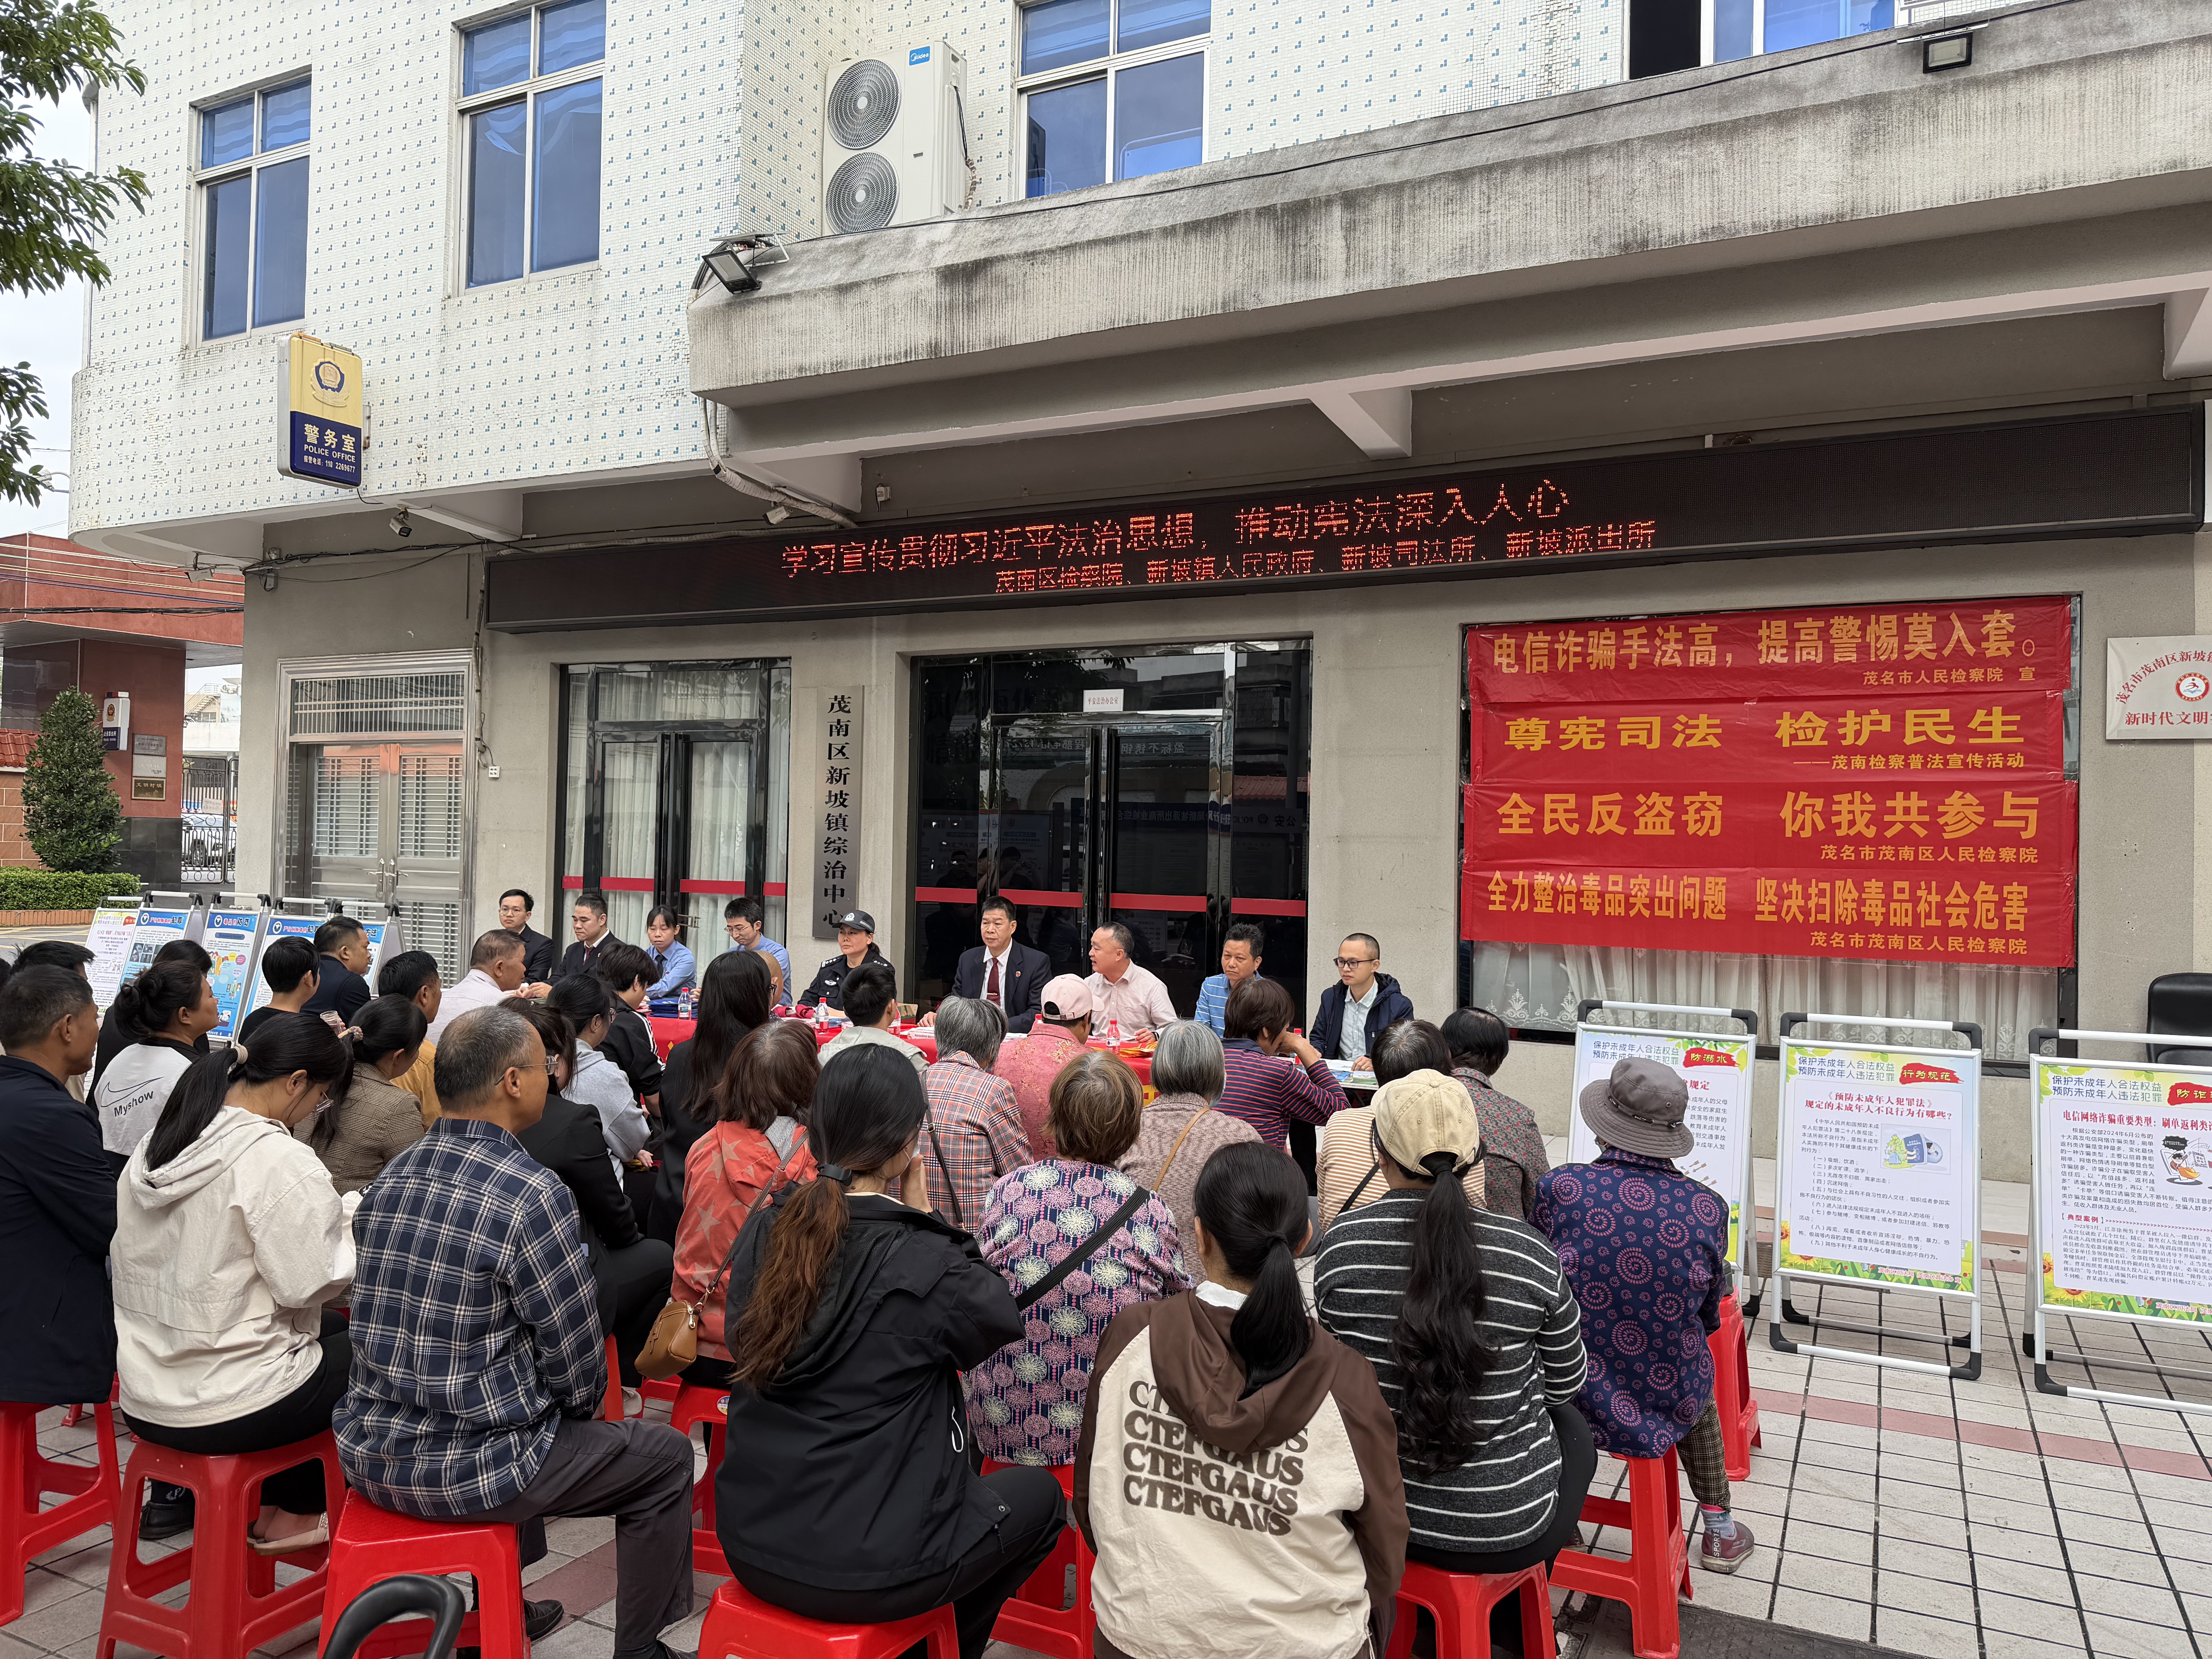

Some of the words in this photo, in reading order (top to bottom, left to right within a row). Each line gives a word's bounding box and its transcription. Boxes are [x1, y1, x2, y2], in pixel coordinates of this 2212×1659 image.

[910, 52, 929, 62] Midea
[304, 423, 356, 453] 警务室
[304, 444, 329, 457] POLICE
[332, 451, 356, 463] OFFICE
[335, 462, 355, 473] 2269677
[1862, 667, 2004, 685] 茂名市人民检察院
[2019, 666, 2036, 682] 宣
[1088, 697, 1119, 705] 平安法治办公室
[2124, 711, 2212, 726] 新时代文明
[1504, 713, 1722, 751] 尊宪司法
[1775, 706, 2024, 748] 检护民生
[823, 695, 852, 926] 茂南区新坡镇综治中心
[1497, 791, 1722, 837] 全民反盗窃
[1779, 790, 2040, 840] 你我共参与
[1820, 844, 2039, 864] 茂名市茂南区人民检察院
[1487, 870, 1726, 921] 全力整治毒品突出问题
[1755, 877, 2028, 932] 坚决扫除毒品社会危害
[1810, 931, 2028, 955] 茂名市茂南区人民检察院
[1594, 1041, 1679, 1056] 保护未成年人合法权益
[1690, 1053, 1728, 1064] 防溺水
[1798, 1056, 1895, 1072] 保护未成年人合法权益
[1798, 1066, 1895, 1082] 预防未成年人违法犯罪
[1903, 1069, 1951, 1081] 行为规范
[2052, 1075, 2162, 1092] 保护未成年人合法权益
[1827, 1091, 1933, 1108] 《预防未成年人犯罪法》
[2052, 1085, 2162, 1103] 预防未成年人违法犯罪
[2176, 1088, 2212, 1100] 防诈
[113, 1089, 154, 1118] Myshow
[1805, 1099, 1952, 1120] 规定的未成年人不良行为有哪些？
[1690, 1123, 1727, 1132] 教育未成年人
[1123, 1442, 1298, 1516] CTEFGAUS
[1123, 1475, 1291, 1536] CTEFGAUS
